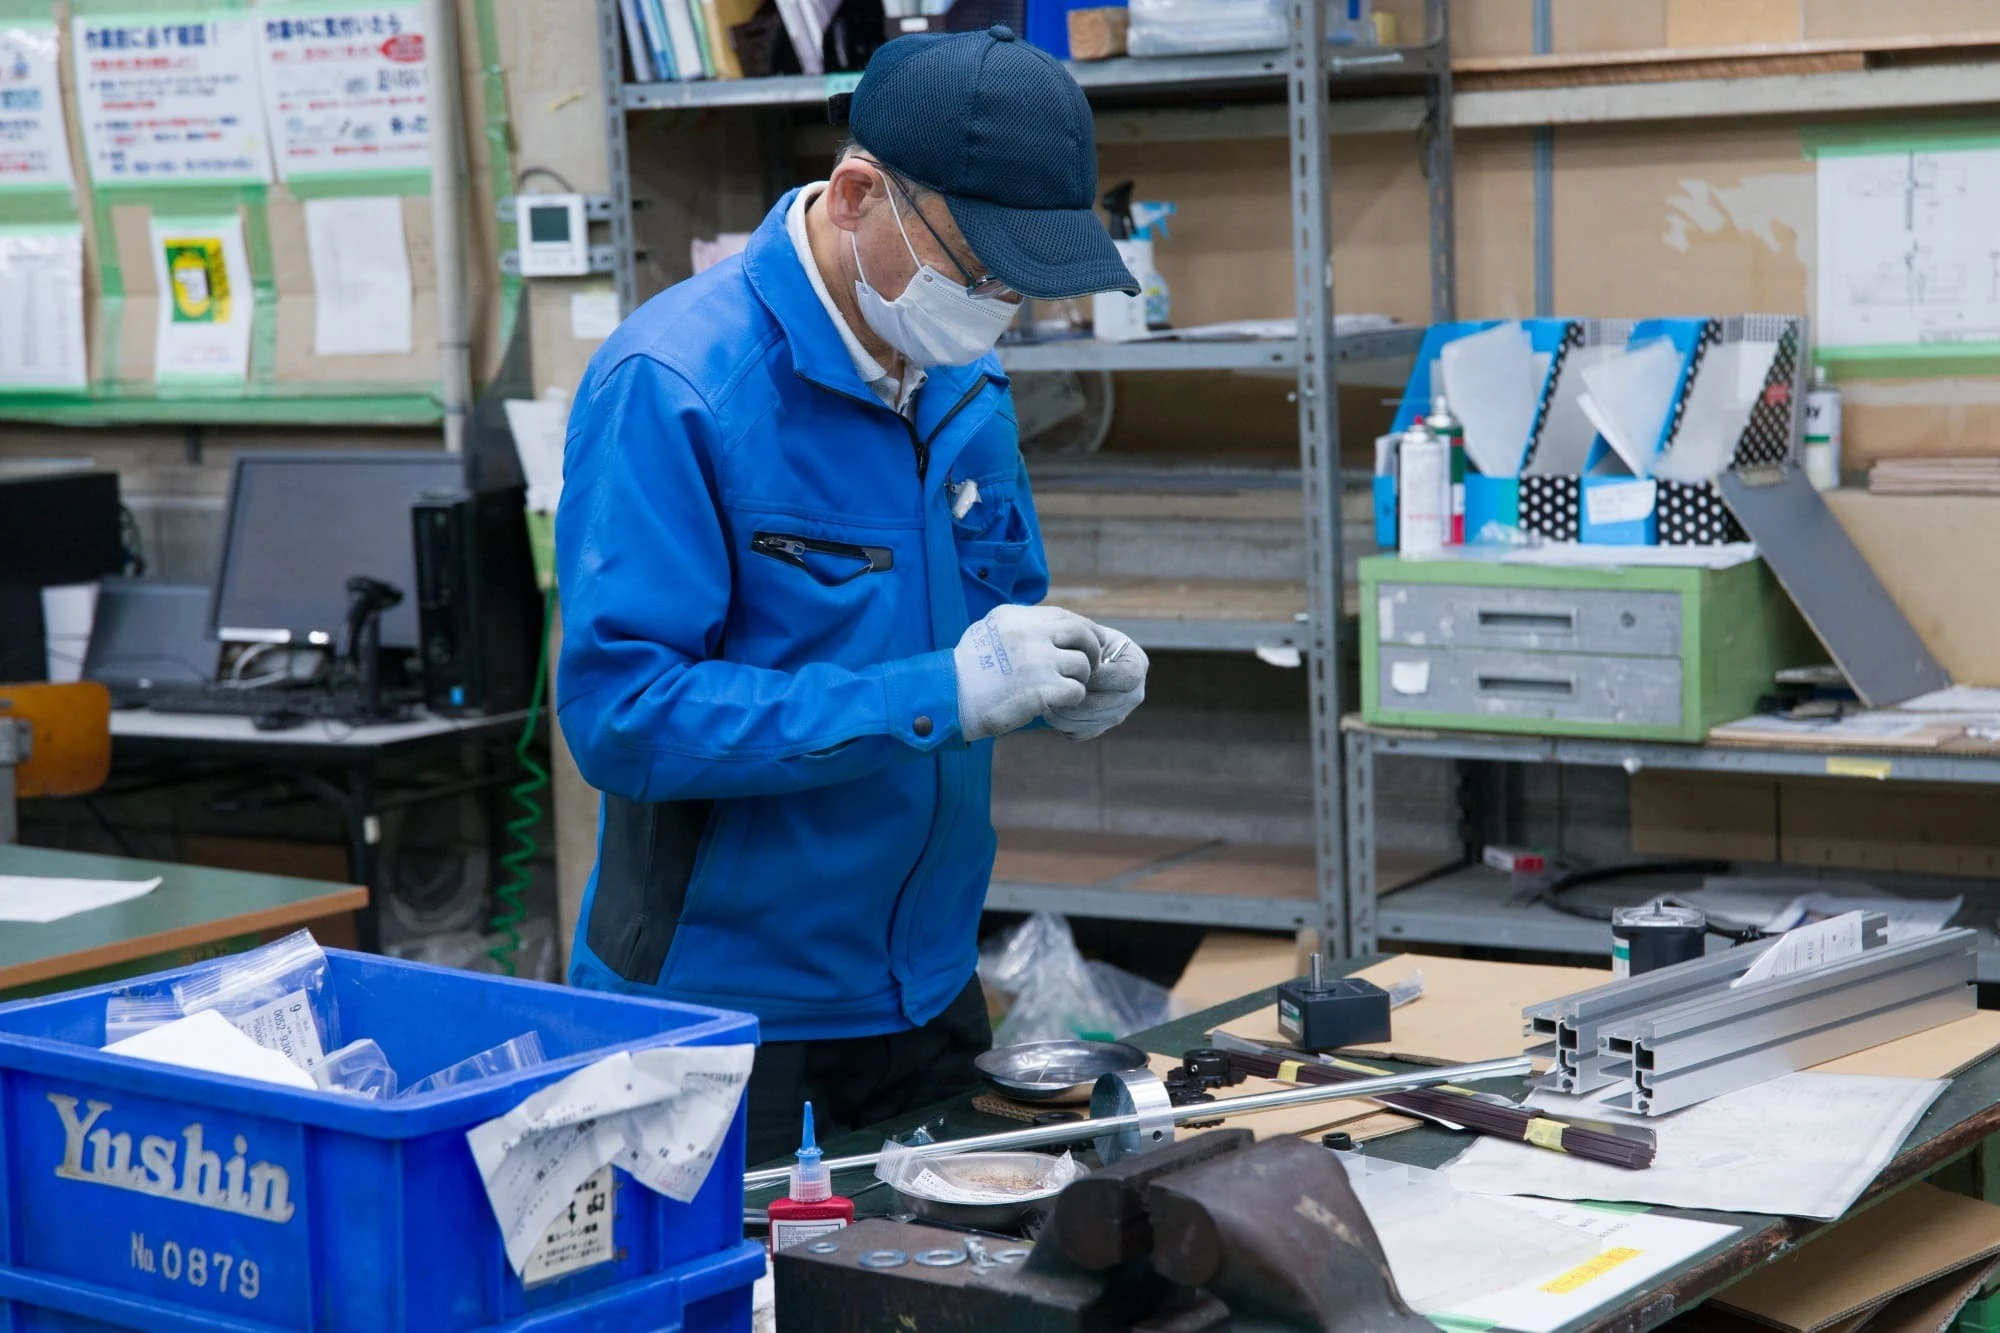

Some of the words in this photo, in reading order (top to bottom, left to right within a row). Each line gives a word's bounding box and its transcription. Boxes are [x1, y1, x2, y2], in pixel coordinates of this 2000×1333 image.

[289, 1003, 302, 1013] 9
[47, 1091, 296, 1225] Yushin
[162, 1240, 260, 1300] 0879
